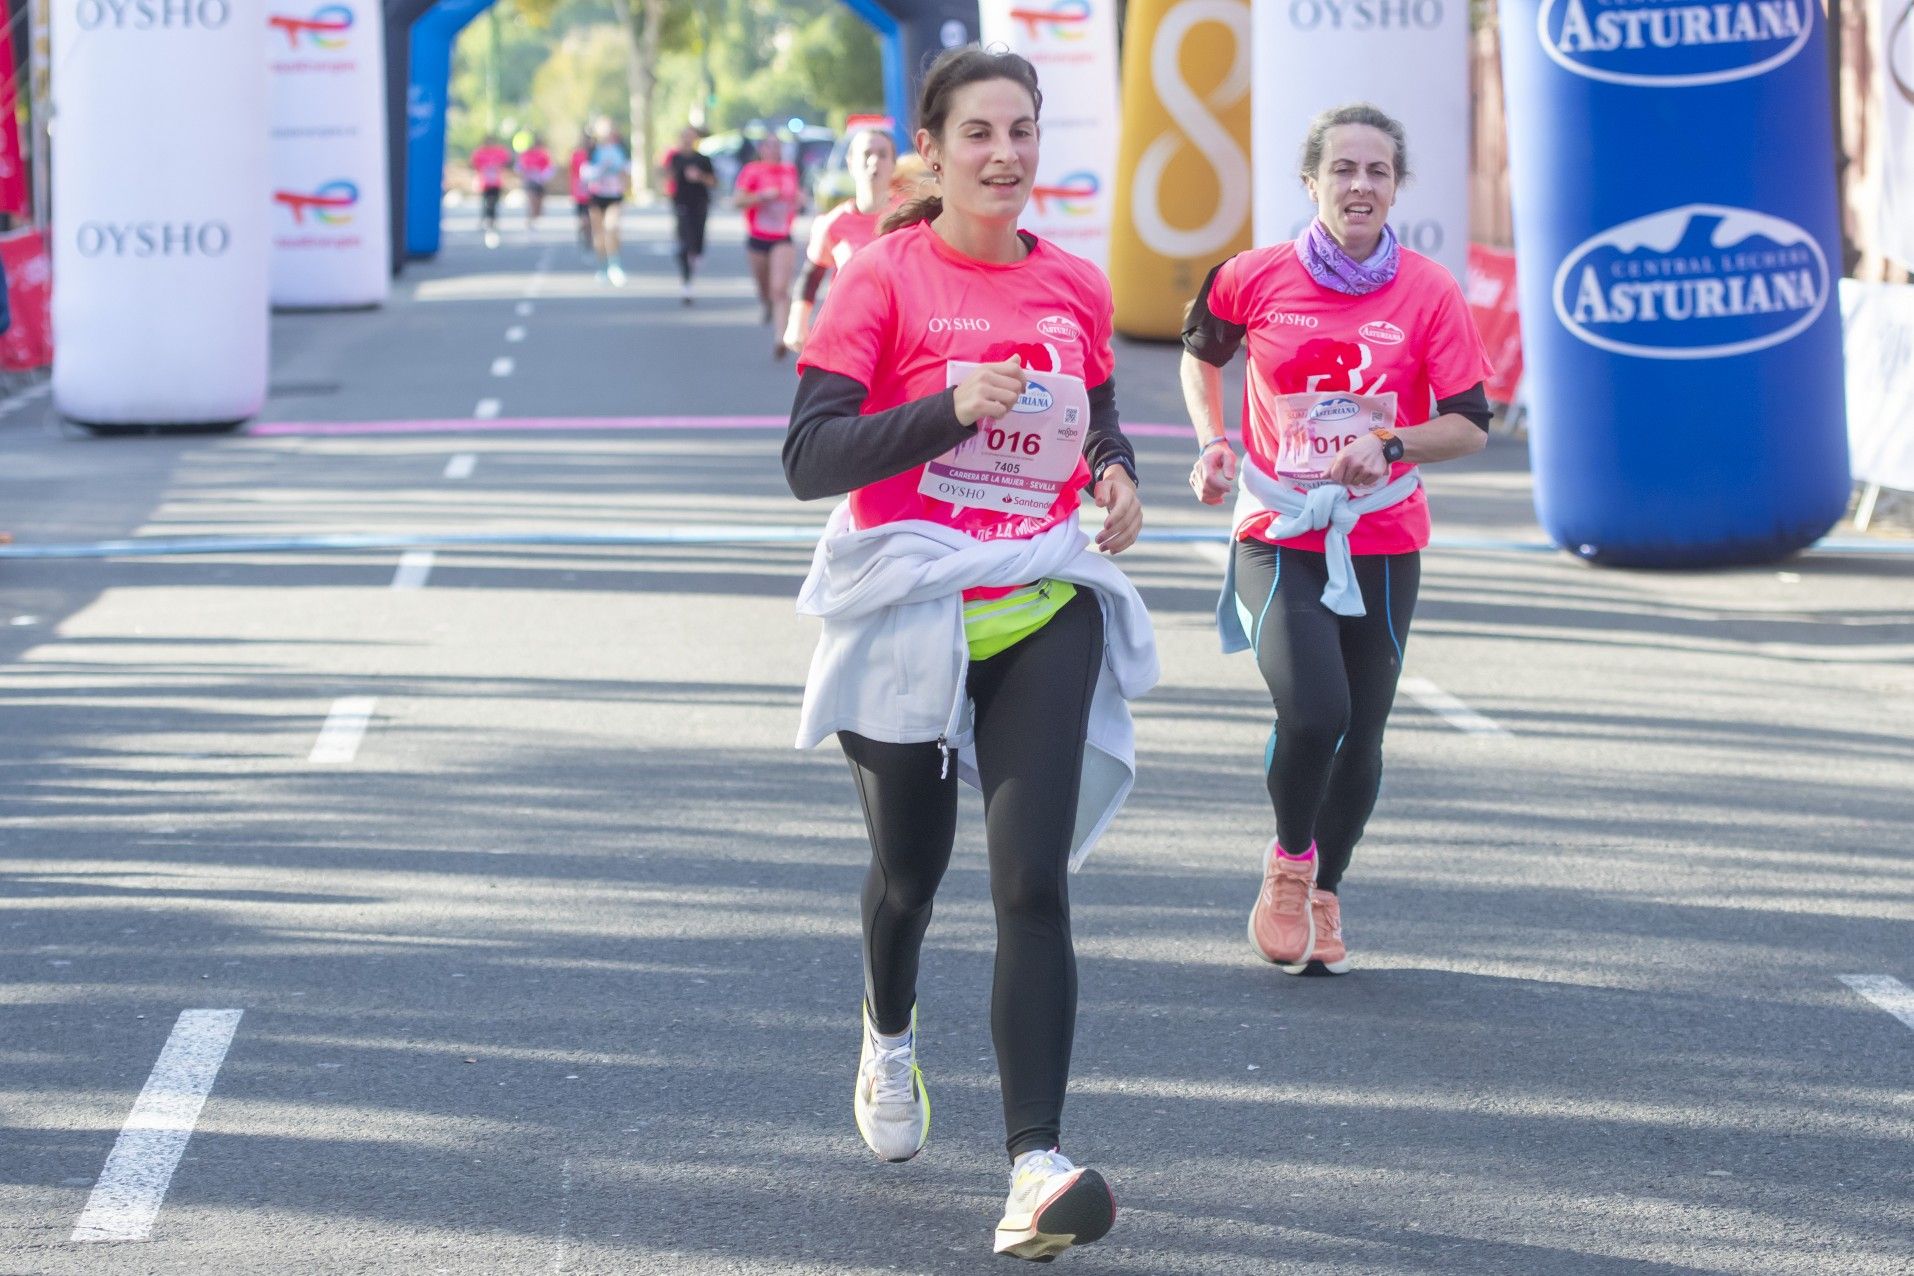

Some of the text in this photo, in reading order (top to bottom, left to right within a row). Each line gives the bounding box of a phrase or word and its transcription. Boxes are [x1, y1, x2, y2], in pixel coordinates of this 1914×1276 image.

[76, 0, 232, 31] OYSHO
[1288, 0, 1444, 32] OYSHO
[1553, 0, 1802, 53] ASTURIANA
[76, 218, 232, 259] OYSHO
[1572, 264, 1816, 323] ASTURIANA
[928, 317, 990, 333] OYSHO
[1266, 310, 1318, 329] OYSHO
[987, 428, 1042, 456] 016
[949, 469, 1057, 491] CARRERA DE LA MUJER SEVILLA
[994, 461, 1021, 474] 7405
[938, 482, 985, 501] OYSHO
[996, 522, 1013, 538] LA
